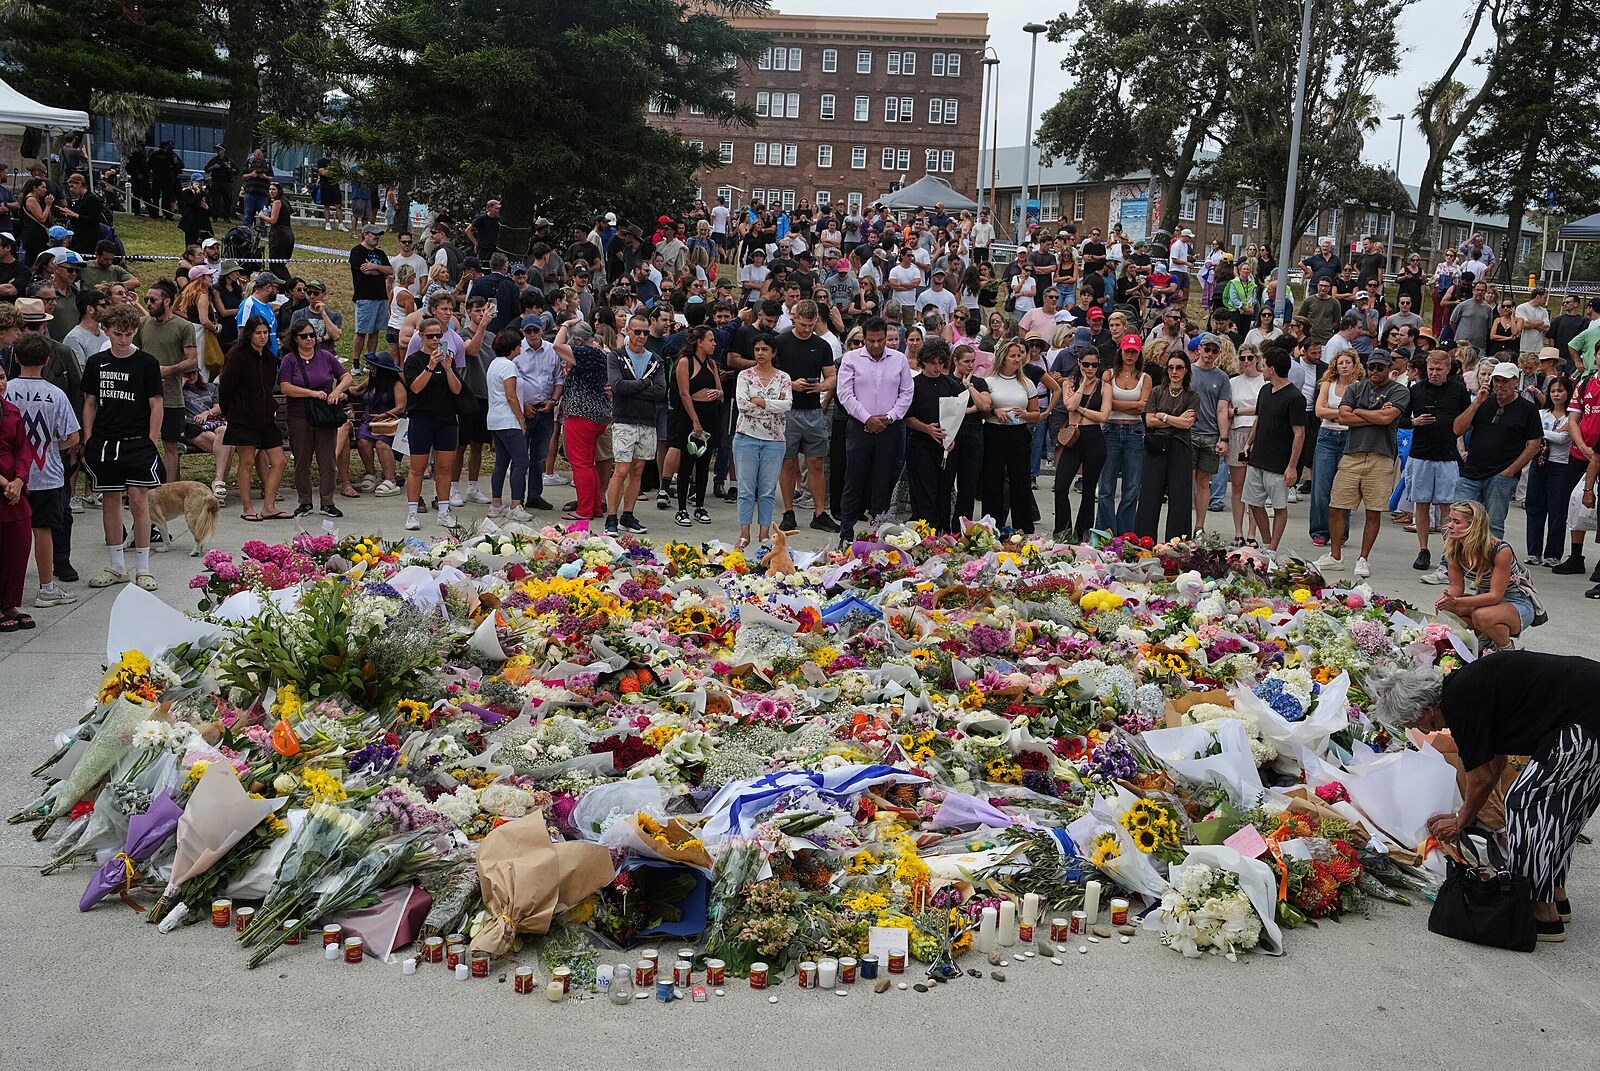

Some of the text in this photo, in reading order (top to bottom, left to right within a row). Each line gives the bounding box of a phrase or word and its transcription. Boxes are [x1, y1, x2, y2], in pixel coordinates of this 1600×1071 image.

[831, 283, 853, 294] DEUS
[100, 370, 130, 381] BROOKLYN
[100, 389, 136, 402] BASKETBALL
